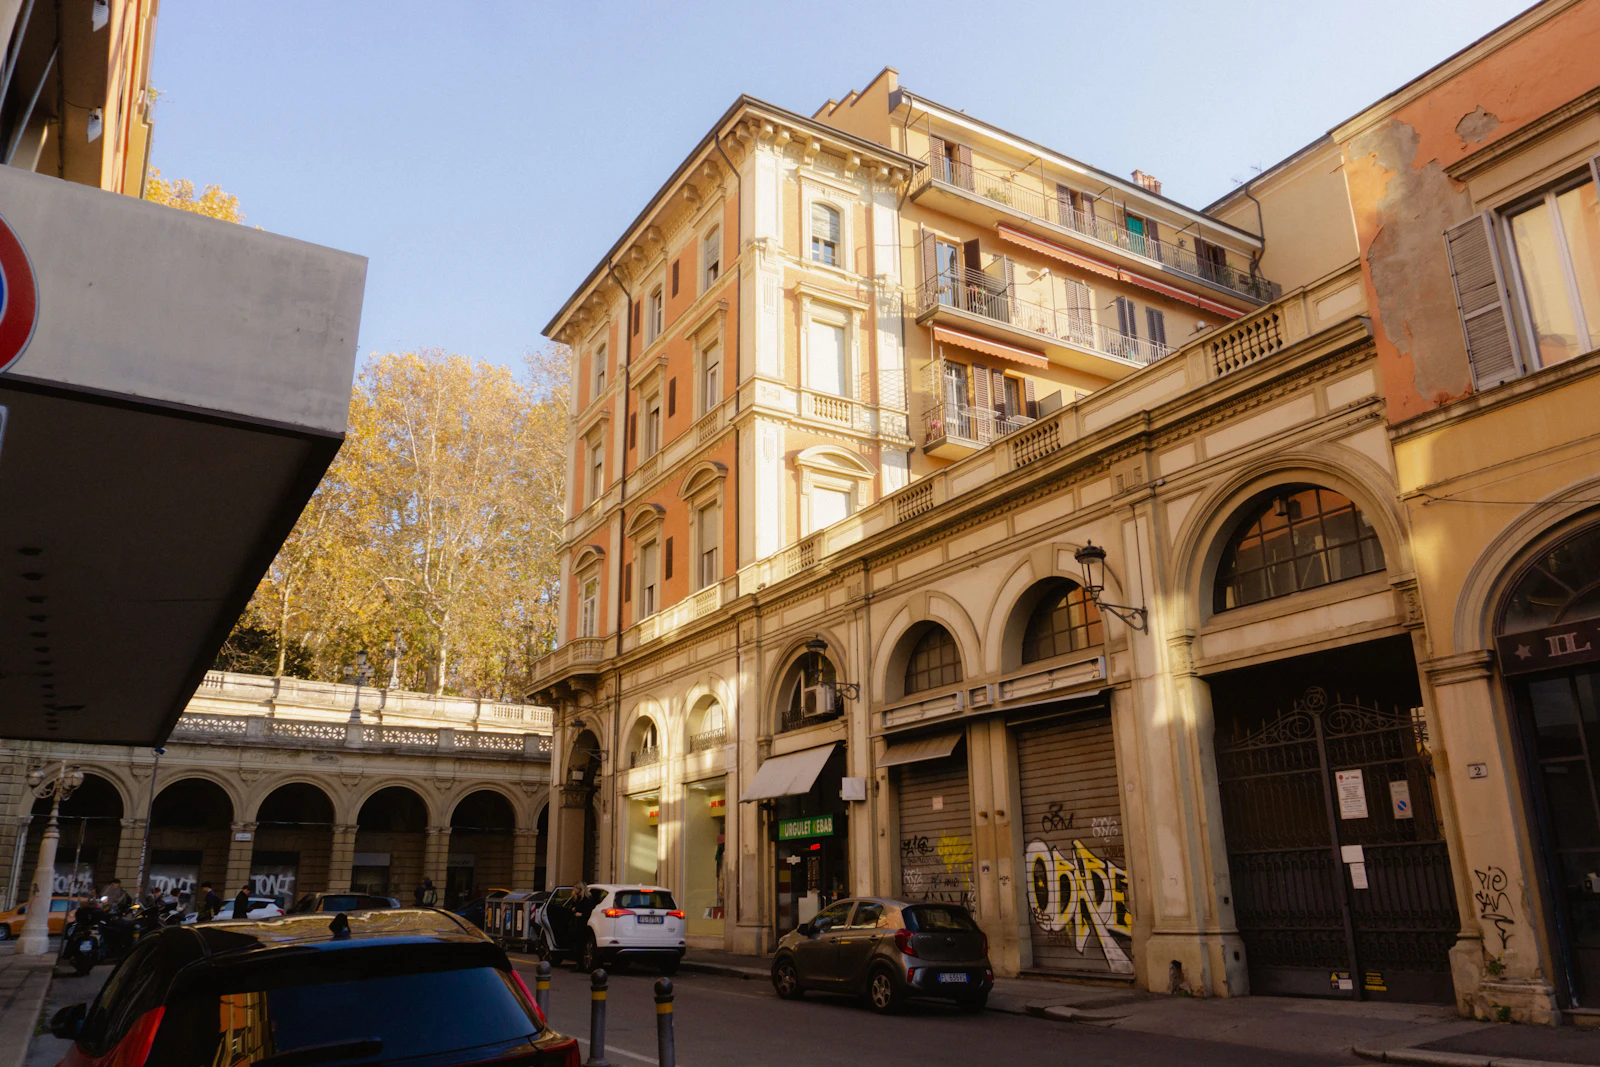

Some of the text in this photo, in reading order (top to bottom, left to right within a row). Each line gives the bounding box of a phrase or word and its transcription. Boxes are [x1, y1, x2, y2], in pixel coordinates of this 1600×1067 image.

[1545, 632, 1592, 657] IL
[1474, 766, 1482, 776] 2
[812, 817, 833, 834] KEBAB
